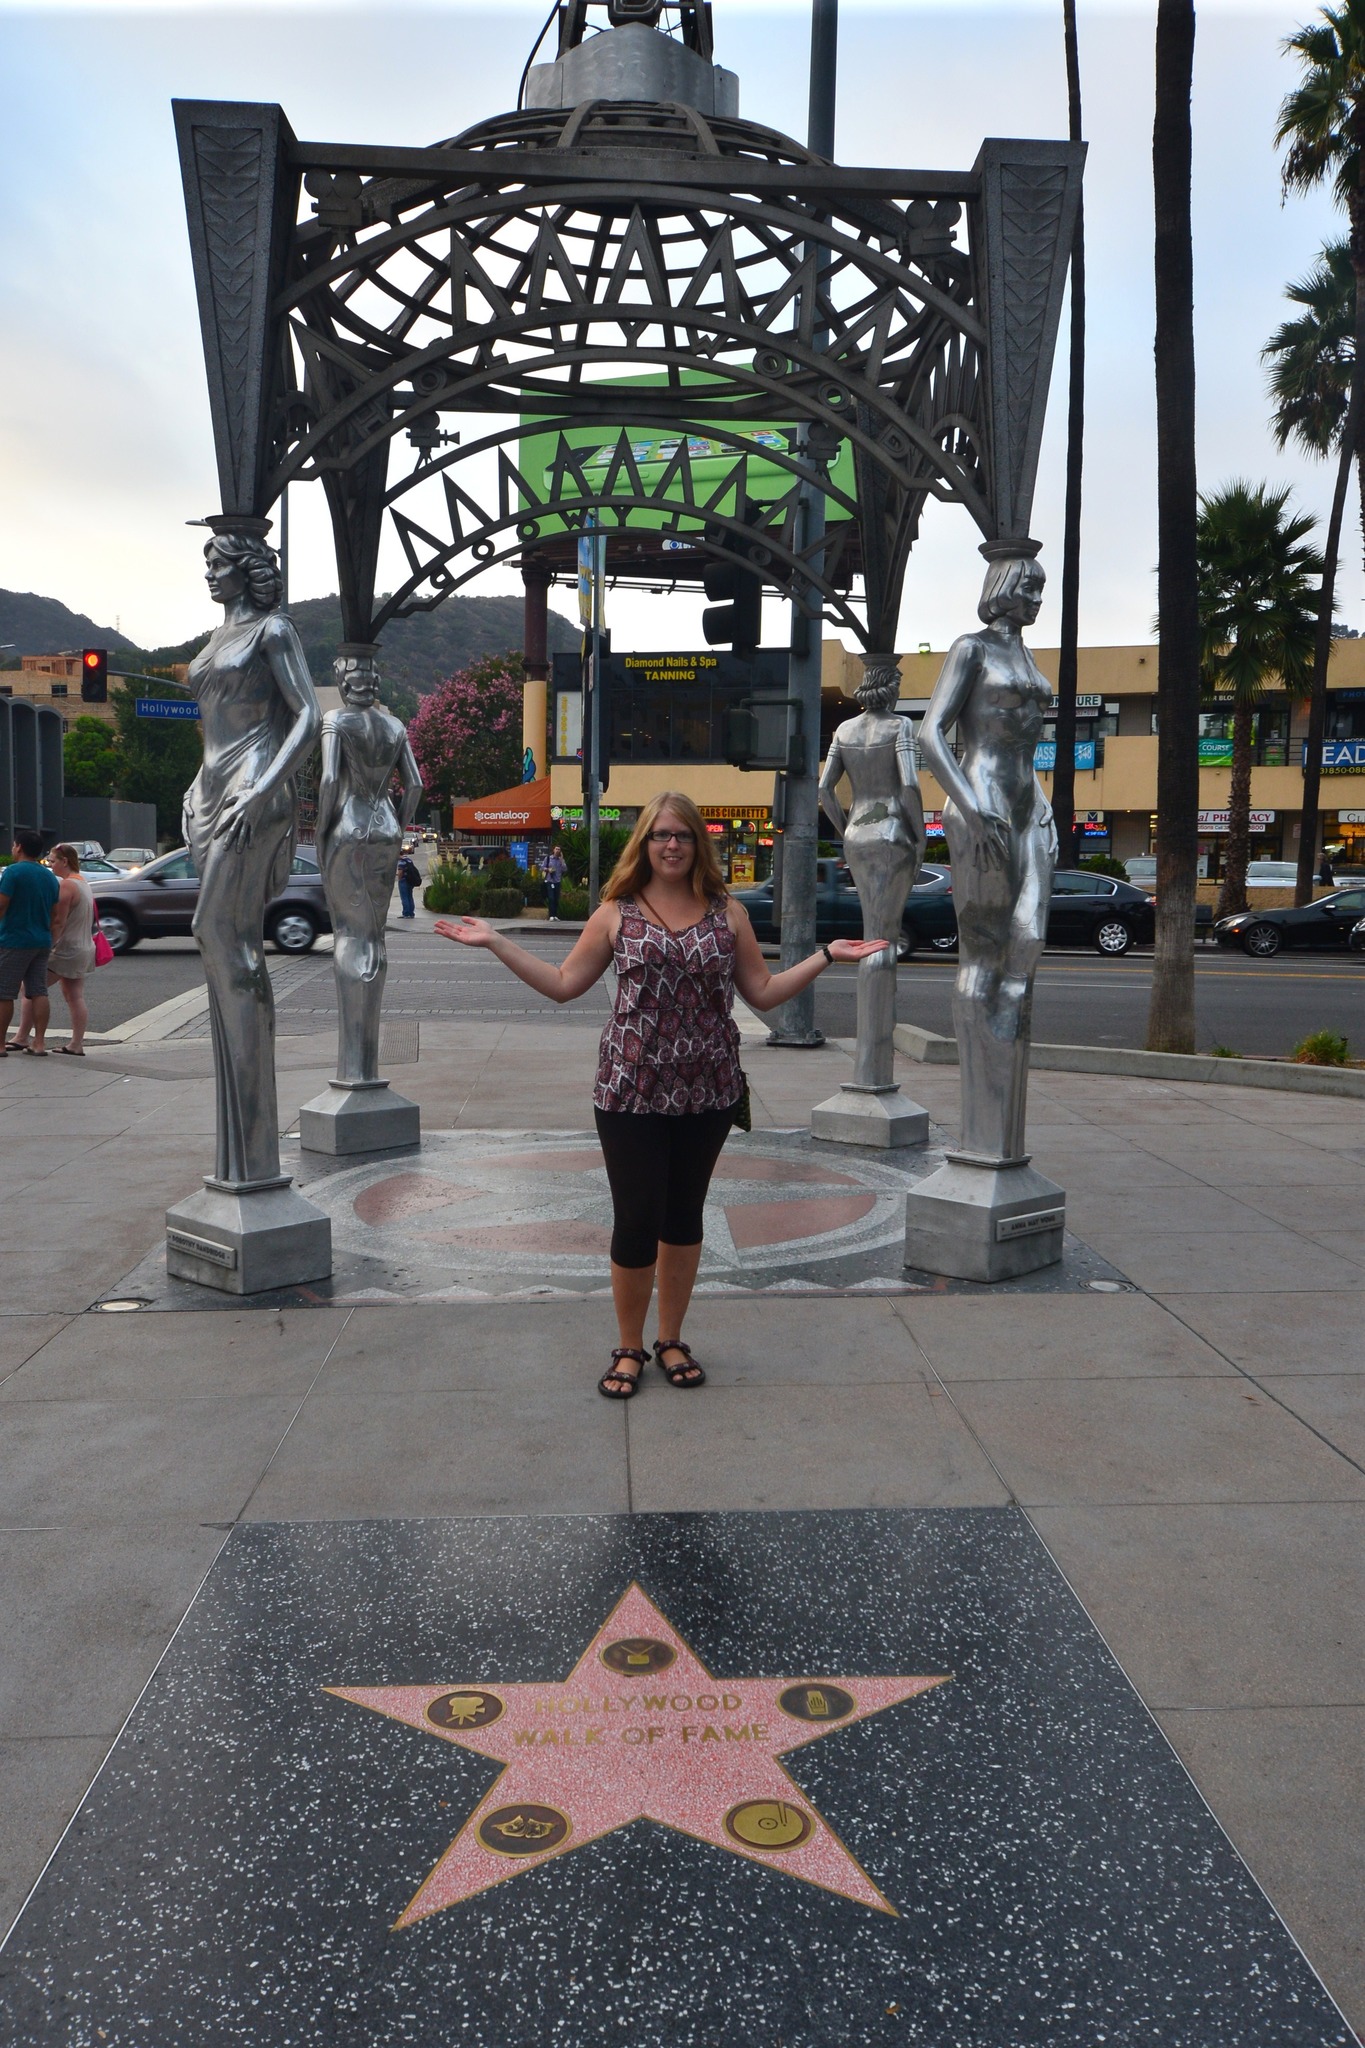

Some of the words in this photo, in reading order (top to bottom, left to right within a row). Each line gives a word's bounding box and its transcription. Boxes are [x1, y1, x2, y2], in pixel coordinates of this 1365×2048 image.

[625, 657, 664, 668] Diamond
[666, 656, 689, 667] Nails
[690, 657, 697, 666] &
[699, 656, 717, 668] Spa
[645, 671, 696, 681] TANNING
[141, 702, 199, 715] Hollywood
[1304, 745, 1365, 765] EAD
[484, 810, 530, 825] cantaloop
[562, 808, 621, 820] canoop
[699, 807, 722, 818] GARS
[722, 807, 765, 818] CIGARETTE
[1347, 812, 1365, 823] CL
[535, 1694, 743, 1715] HOLLYWOOD
[513, 1728, 603, 1746] WALK
[621, 1726, 666, 1745] OF
[682, 1723, 771, 1744] FAME
